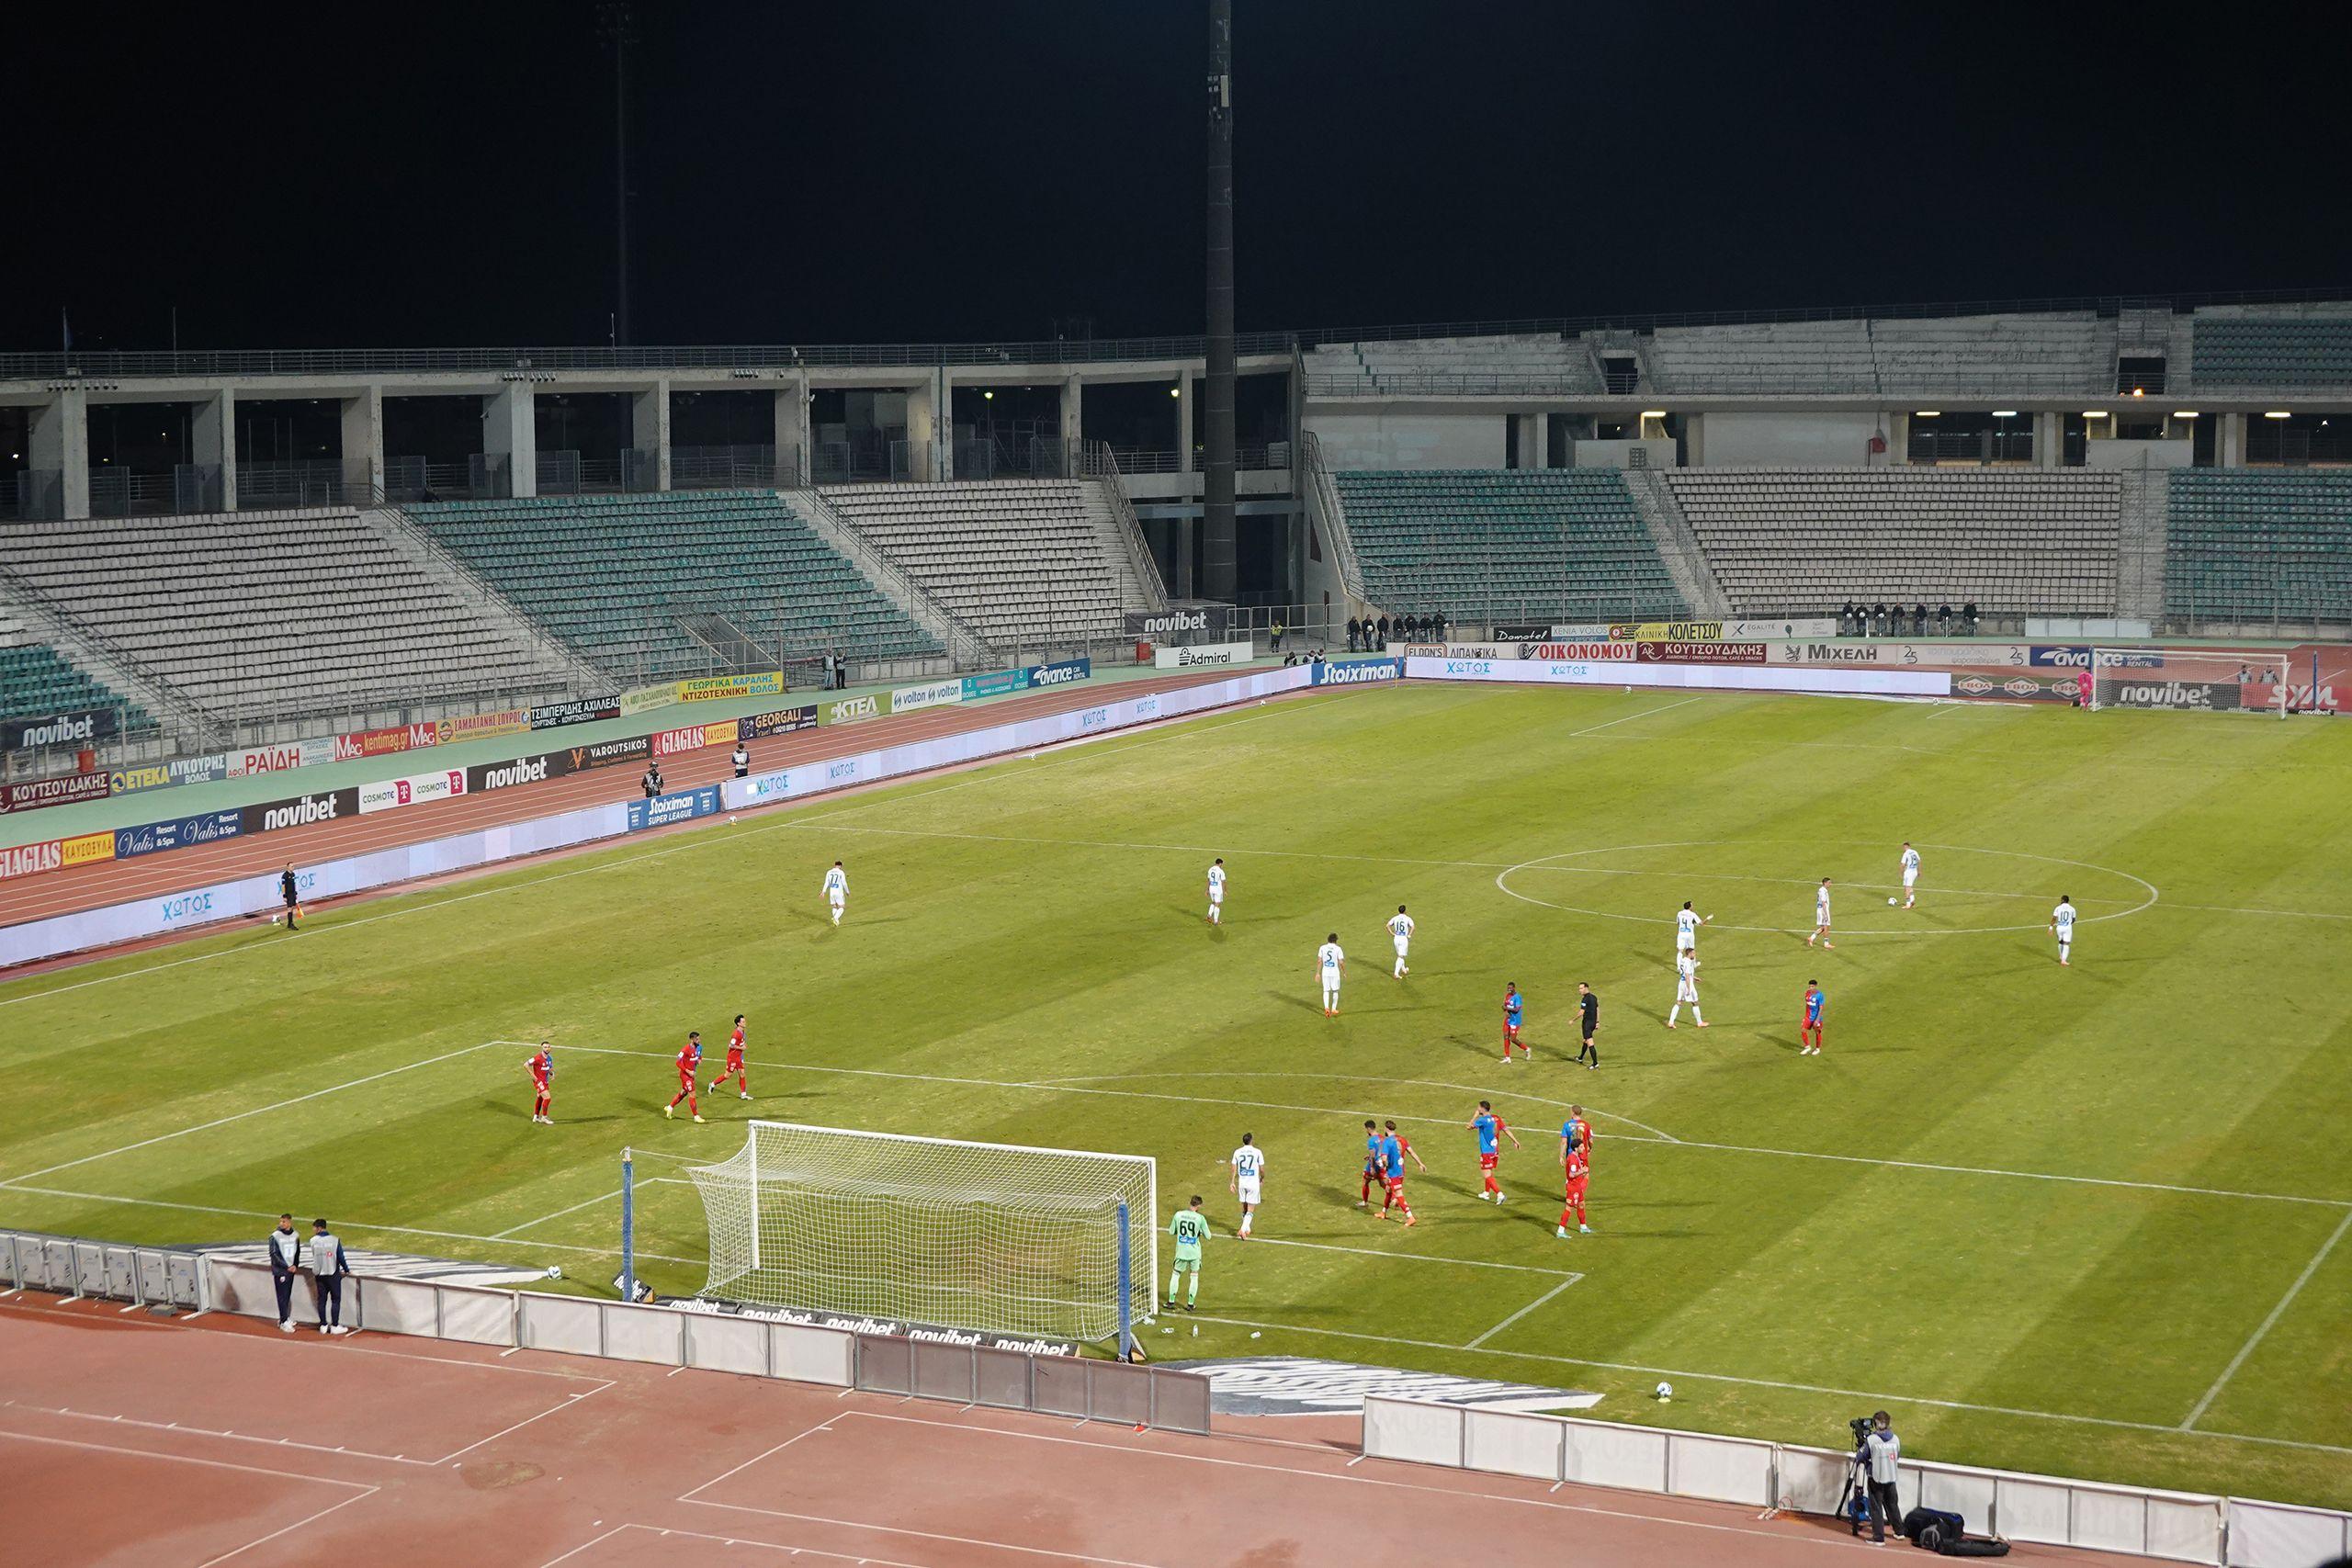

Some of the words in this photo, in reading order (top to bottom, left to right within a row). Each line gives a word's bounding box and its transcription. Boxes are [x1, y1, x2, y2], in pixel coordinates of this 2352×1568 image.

[1145, 611, 1207, 633] novibet
[1579, 626, 1608, 635] VOLOS
[1497, 630, 1548, 641] Domotel
[1668, 624, 1723, 640] ΚΟΛΕΤΣΟΥ
[1190, 651, 1231, 665] Admiral
[1539, 644, 1634, 660] ΟΙΚΟΝΟΜΟΥ
[1665, 644, 1763, 656] ΚΟΥΤΣΟΥΔΑΚΗΣ
[1904, 646, 1917, 663] 25
[2010, 647, 2024, 665] 25
[1447, 662, 1490, 673] ΧΩΤΟΣ
[2054, 652, 2123, 667] avace
[1040, 667, 1072, 685] avance
[1320, 663, 1396, 684] Stoiximan
[1551, 666, 1589, 675] ΧΩΤΟΣ
[687, 681, 730, 690] ΓΕΩΡΓΙΚΑ
[733, 674, 774, 686] ΚΑΡΑΛΗΣ
[682, 687, 747, 701] ΝΤΙΖΟΤΕΧΝΙΚΗ
[750, 683, 779, 694] ΒΟΛΟΣ
[903, 692, 926, 704] volton
[937, 685, 959, 698] volton
[2120, 682, 2211, 705] novibet
[2267, 685, 2338, 707] SYM
[531, 702, 582, 719] ΤΣΙΜΠΕΡΙΔΗΣ
[583, 697, 620, 712] ΑΧΙΛΛΕΑΣ
[837, 696, 877, 720] ΚΤΕΛ
[497, 712, 521, 726] ΣΠΥΡΟΣ
[755, 708, 801, 728] GEORGALI
[1082, 709, 1106, 727] ΧΩΤΟΣ
[22, 714, 94, 748] novibet
[410, 724, 435, 746] MAG
[336, 735, 363, 758] MAG
[364, 732, 410, 750] kentimag.gr
[590, 739, 647, 758] VAROUTSIKOS
[662, 727, 705, 754] GIAGIAS
[170, 754, 225, 776] ΛΥΚΟΥΡΗΣ
[228, 767, 244, 777] ΑΦΟΙ
[245, 747, 300, 774] ΡΑΪΔΗ
[830, 762, 854, 779] ΧΩΤΟΣ
[126, 765, 171, 789] ΕΤΕΚΑ
[185, 772, 210, 784] ΒΟΛΟΣ
[485, 756, 547, 789] novibet
[12, 773, 107, 801] ΚΟΥΤΣΟΥΔΑΚΗΣ
[417, 781, 447, 795] COSMOTE
[756, 775, 788, 796] ΧΩΤΟΣ
[363, 791, 394, 803] COSMOTE
[649, 795, 694, 815] Stoiximan
[219, 813, 238, 823] Resort
[265, 793, 337, 830] novibet
[648, 814, 668, 826] SUPER
[668, 808, 693, 822] LEAGUE
[156, 825, 176, 835] Resort
[184, 815, 219, 843] Valis
[118, 827, 154, 855] Valis
[277, 873, 316, 895] ΧΤΟΣ
[1211, 872, 1216, 882] 9
[163, 893, 212, 921] ΧΩΤΟΣ
[2061, 911, 2069, 921] 10
[1396, 920, 1405, 932] 16
[1682, 919, 1688, 929] 4
[1327, 951, 1333, 963] 5
[1240, 1155, 1254, 1169] 27
[1180, 1220, 1196, 1237] 69
[669, 1297, 720, 1313] novibet
[742, 1308, 812, 1324] novibet
[826, 1317, 896, 1336] novibet
[909, 1328, 981, 1346] novibet
[994, 1338, 1069, 1357] novibet
